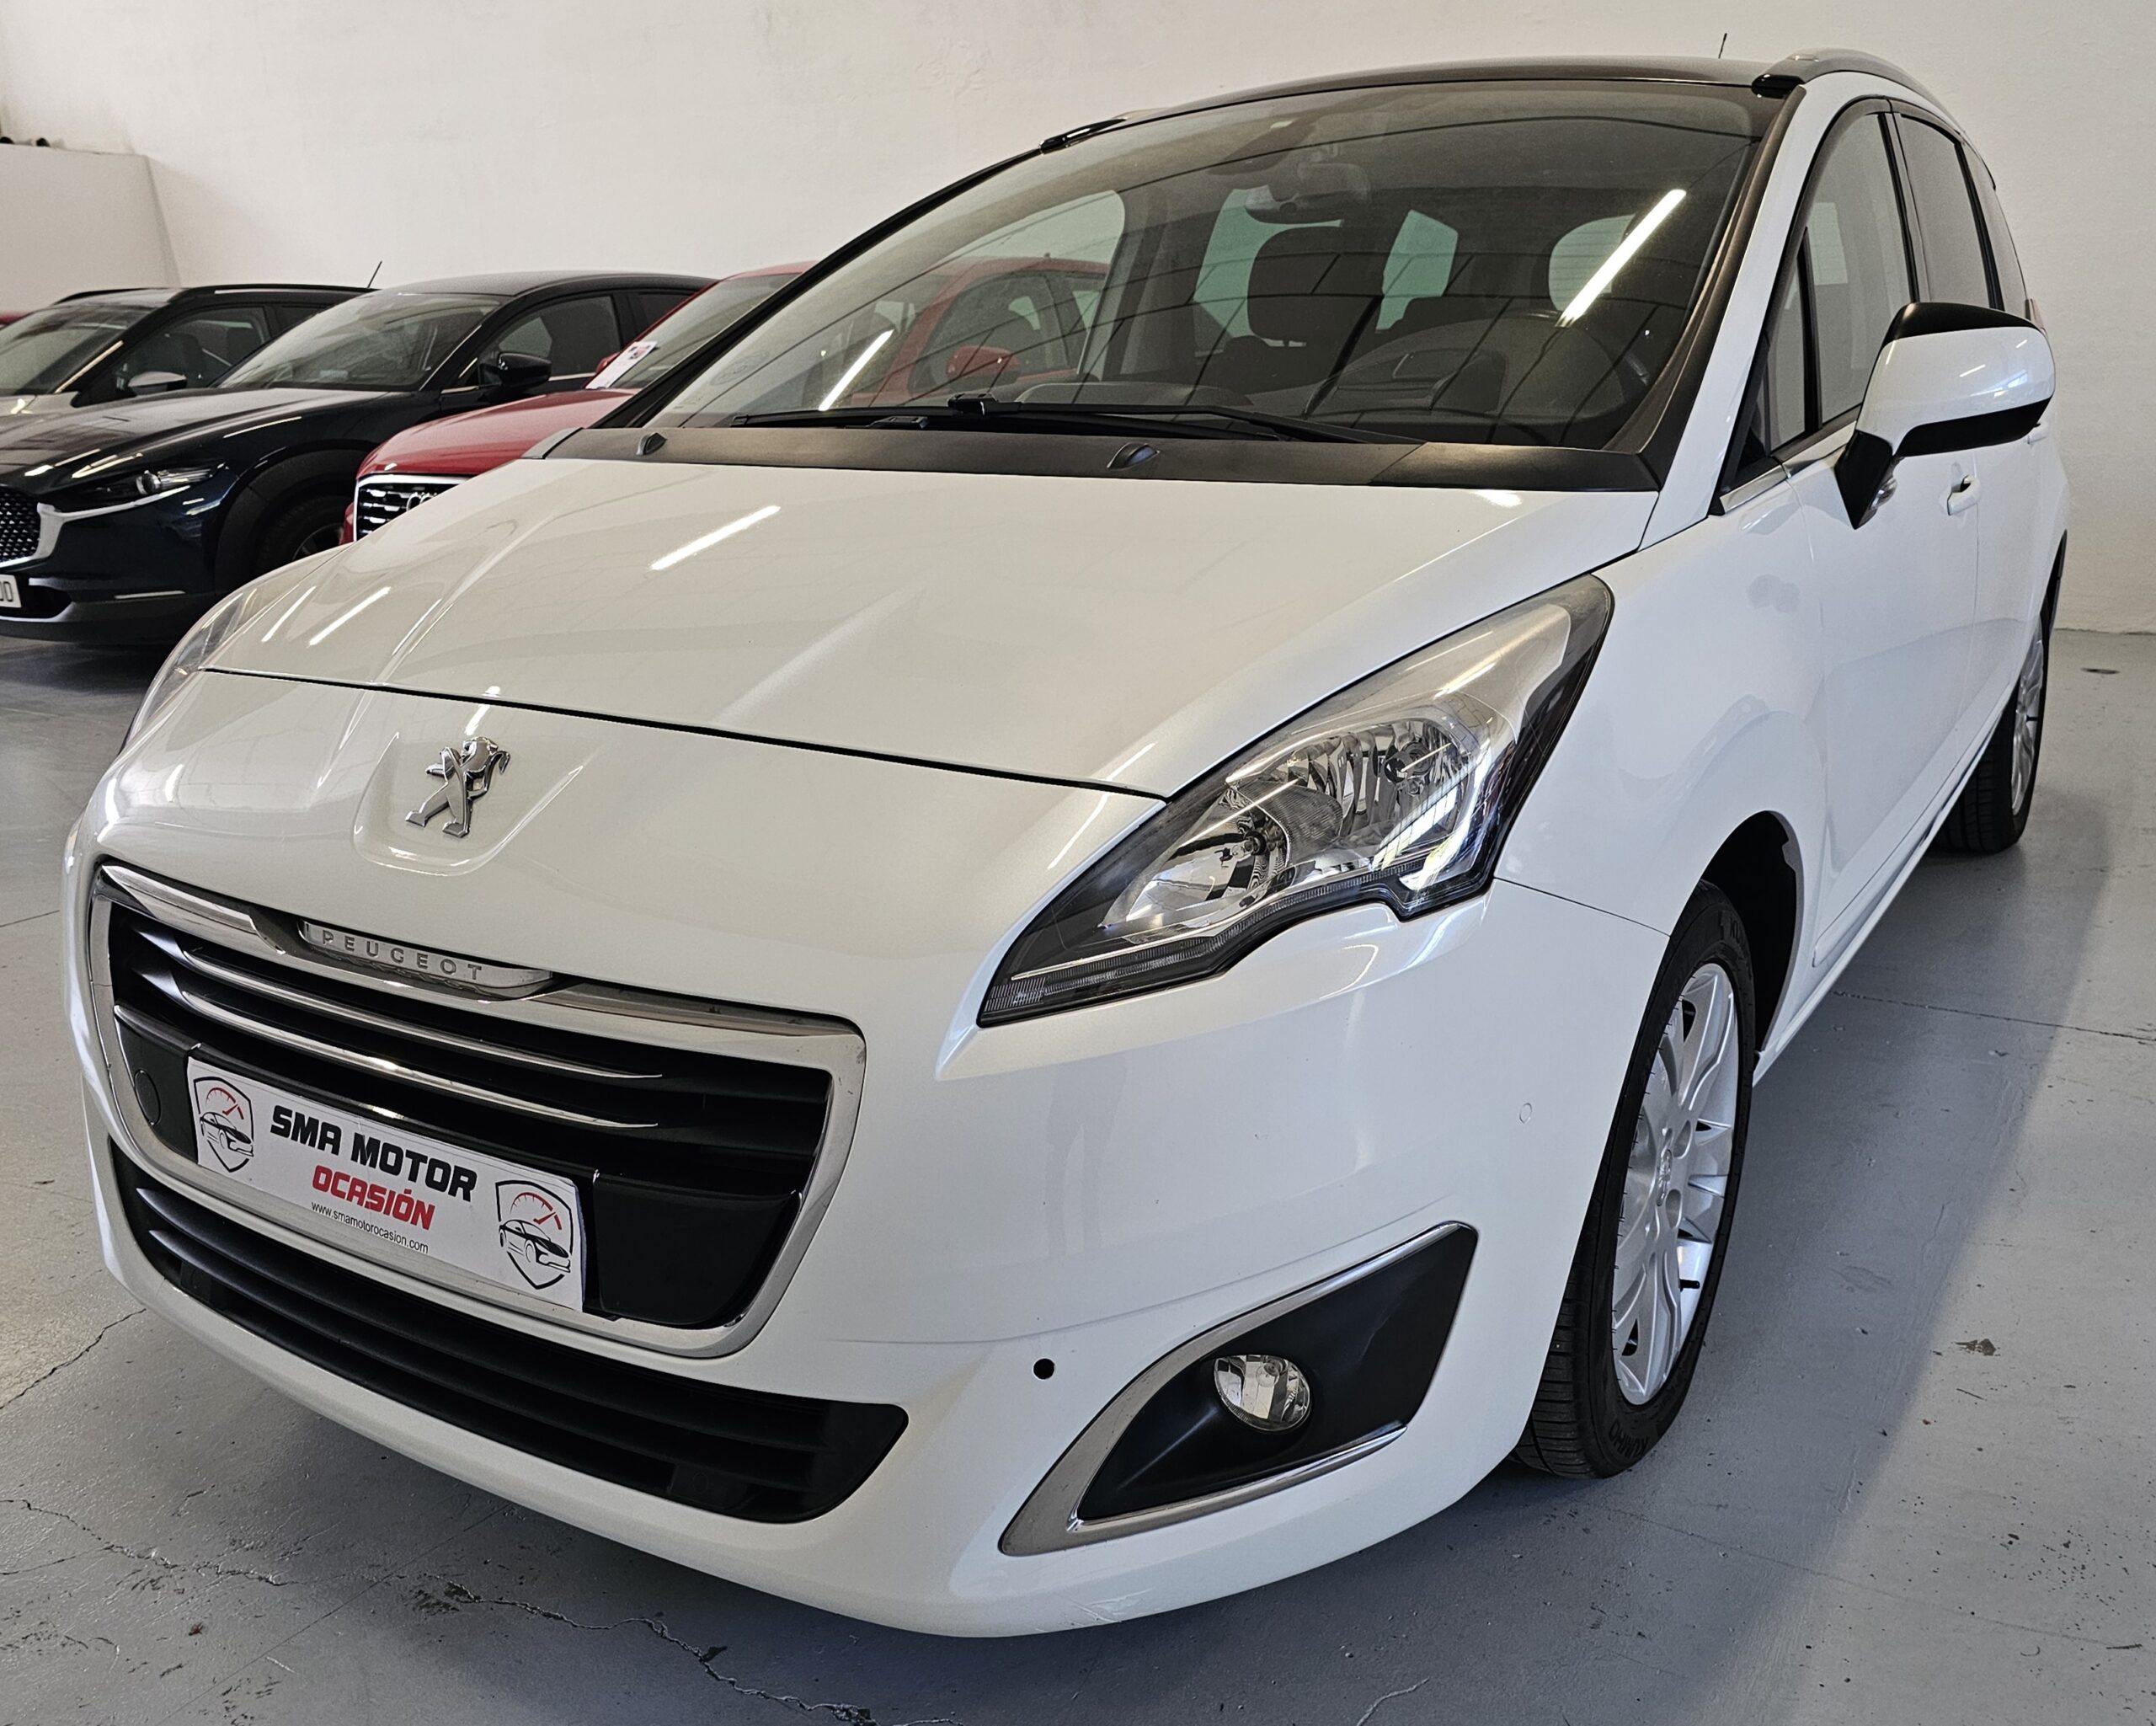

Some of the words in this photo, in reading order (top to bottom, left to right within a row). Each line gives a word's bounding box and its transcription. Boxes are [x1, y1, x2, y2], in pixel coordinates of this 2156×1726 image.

[322, 929, 483, 981] PEUGEOT
[270, 1104, 342, 1156] SMA
[350, 1132, 478, 1202] MOTOR
[312, 1164, 435, 1231] OCASIÓN
[311, 1201, 429, 1253] www.smamotorocasion.com
[1608, 1419, 1649, 1457] KUMHO
